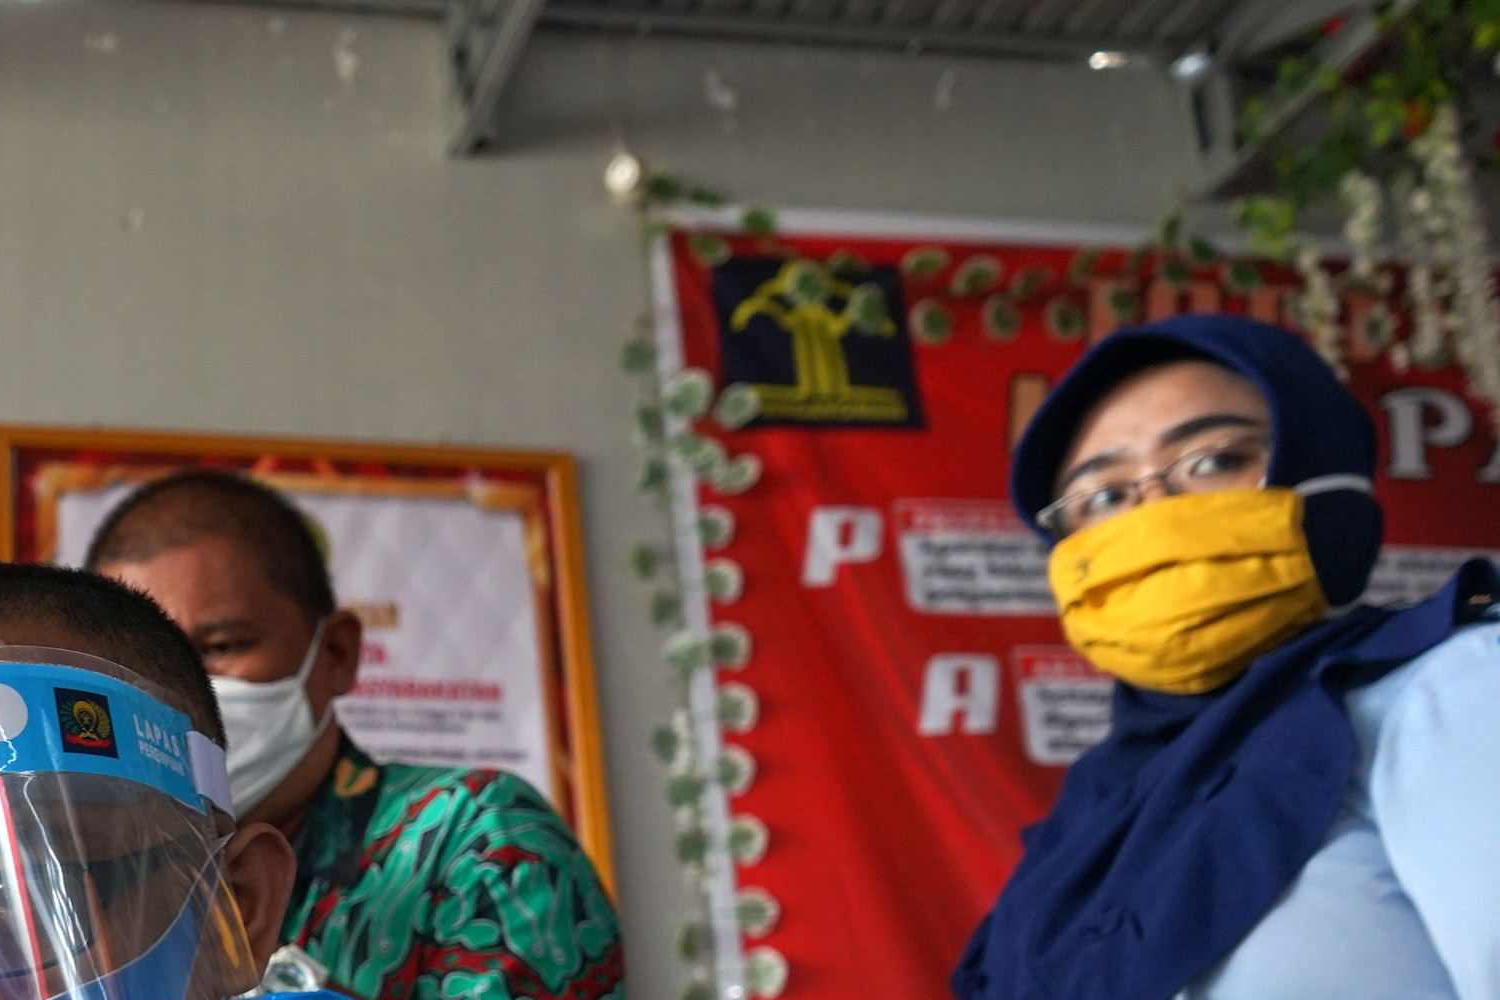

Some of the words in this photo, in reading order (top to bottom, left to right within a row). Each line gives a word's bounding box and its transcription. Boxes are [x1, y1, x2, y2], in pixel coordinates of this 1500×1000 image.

[1378, 386, 1500, 484] P
[802, 506, 882, 588] P
[917, 653, 998, 735] A
[133, 714, 182, 758] LAPAS
